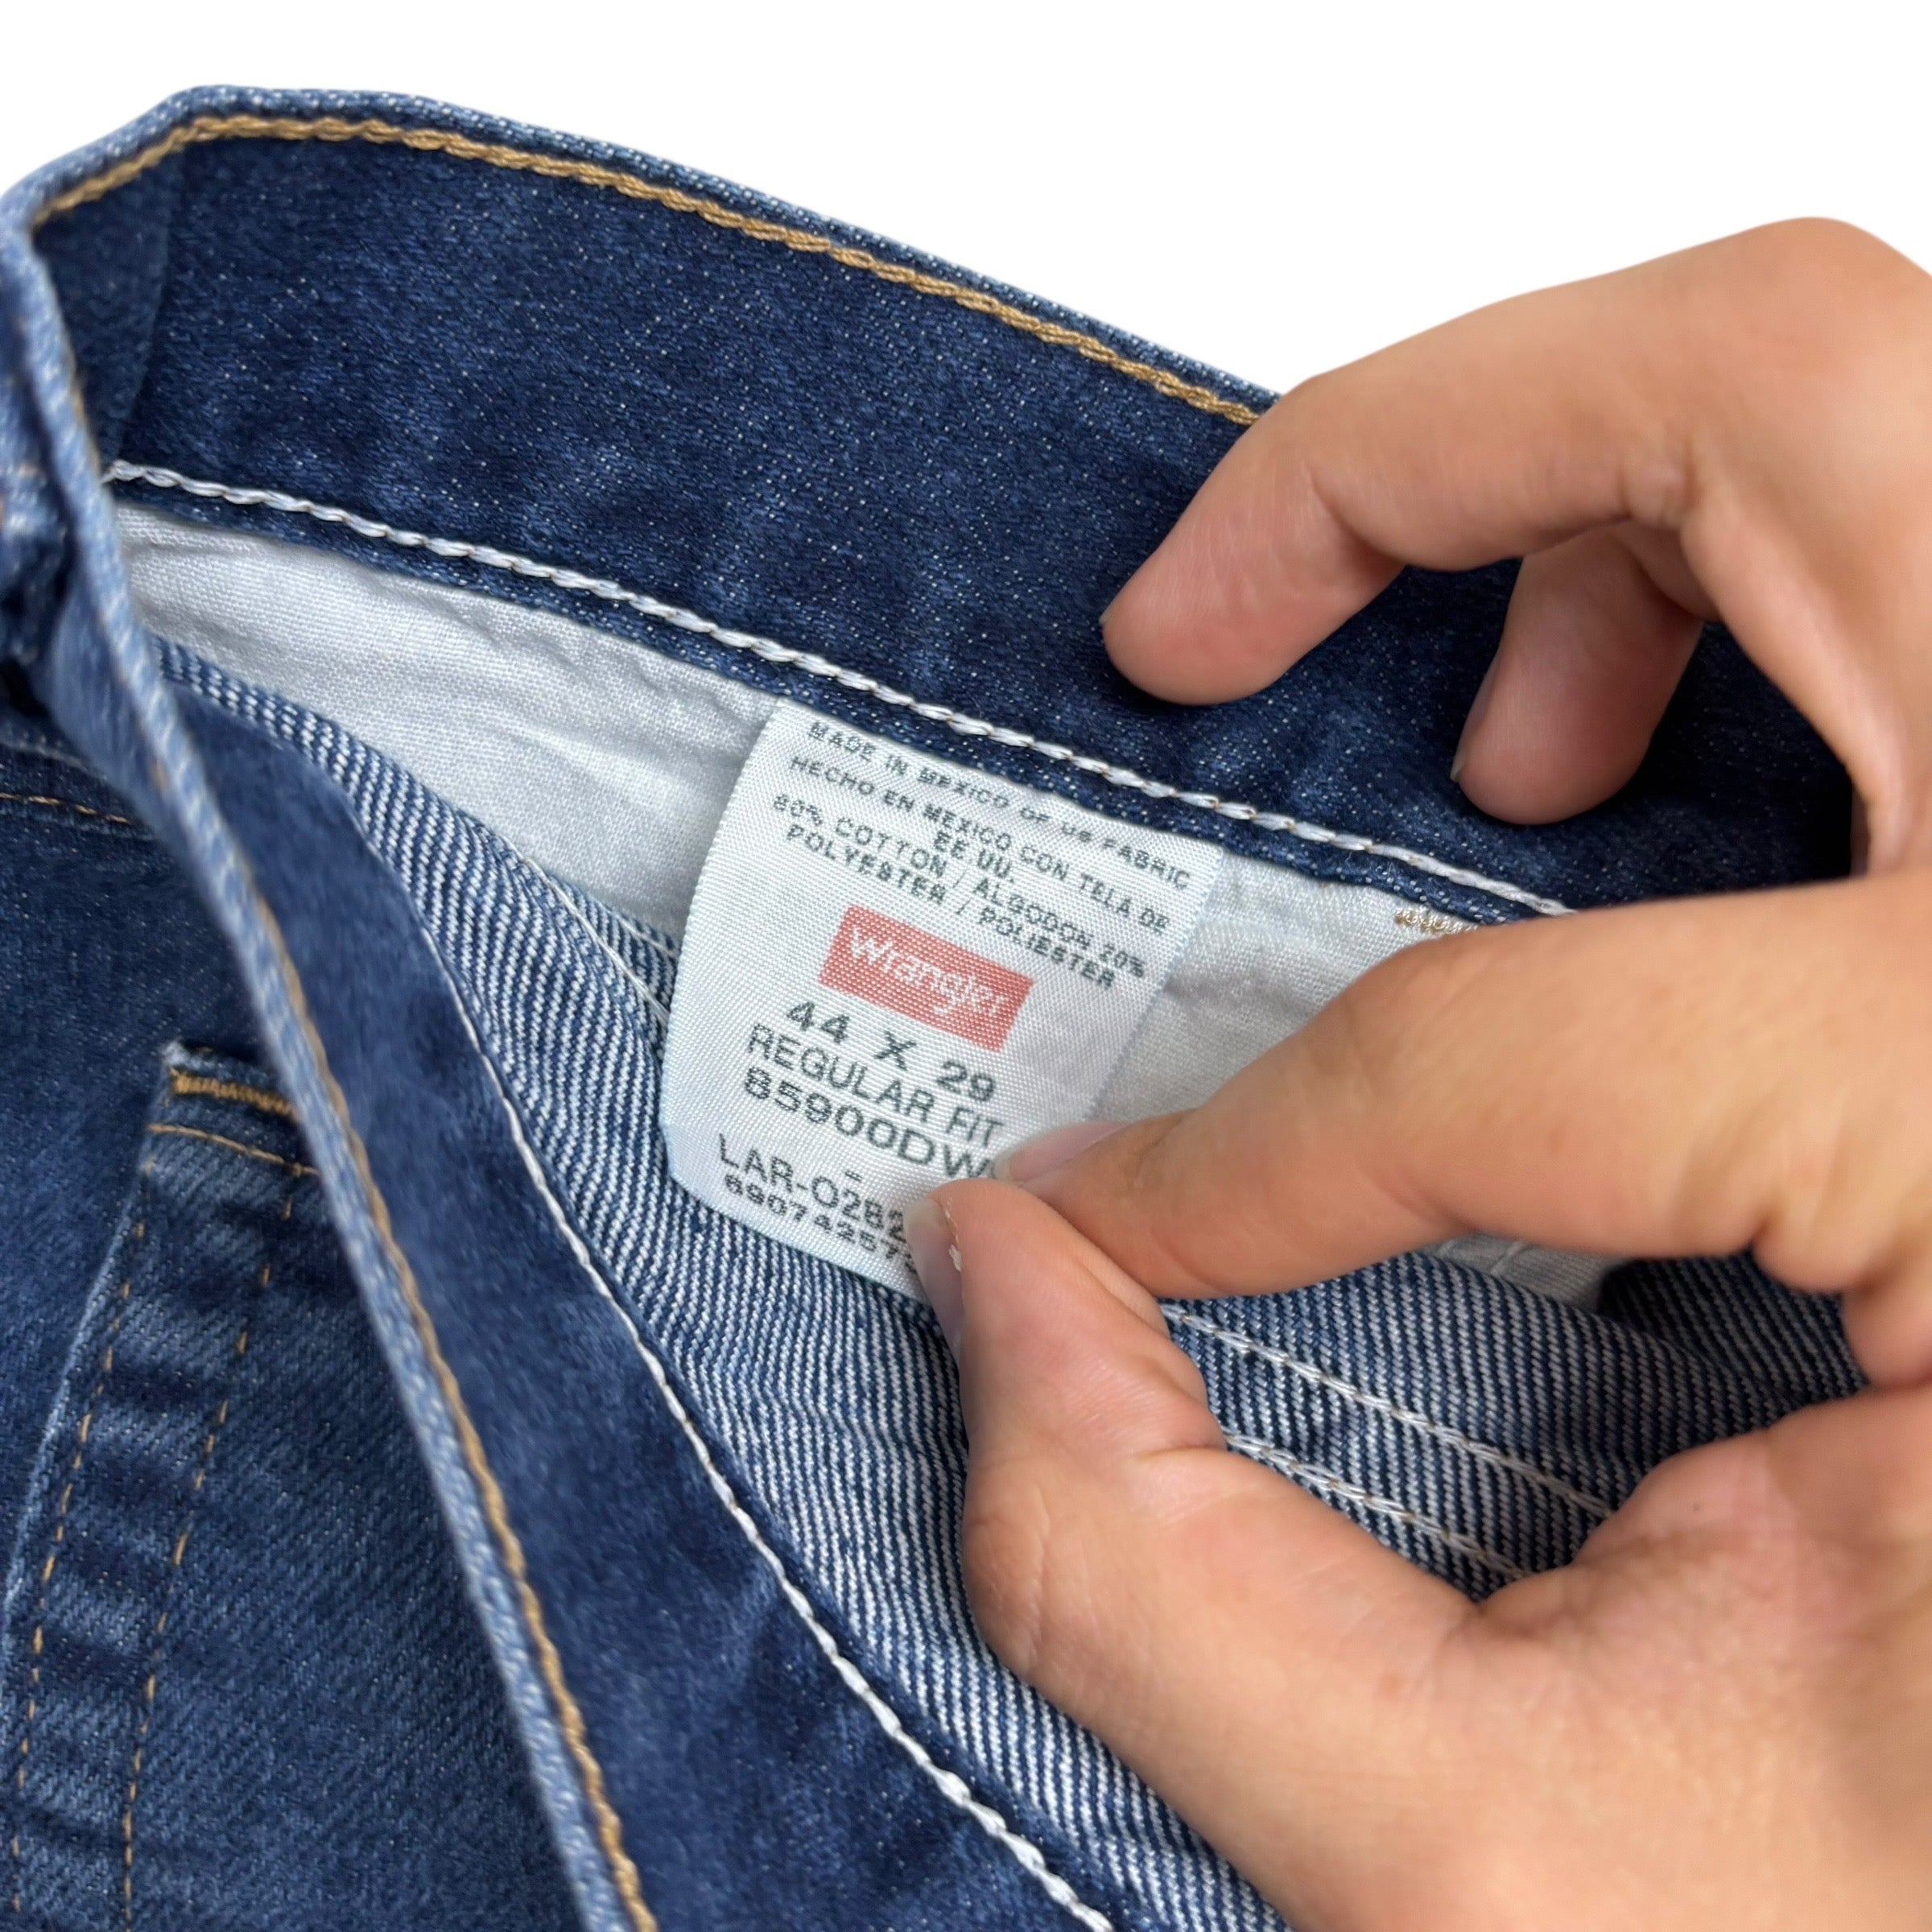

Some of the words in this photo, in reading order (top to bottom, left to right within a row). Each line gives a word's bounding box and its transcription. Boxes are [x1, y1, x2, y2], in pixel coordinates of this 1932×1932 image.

[791, 756, 875, 795] HECHO
[885, 790, 914, 812] EN
[924, 803, 1012, 851] MEXICO
[1020, 846, 1070, 881] CON
[1079, 873, 1132, 918] TELA
[1139, 908, 1170, 935] DE
[807, 721, 876, 762] MADE
[886, 754, 908, 776] IN
[918, 769, 1009, 808] MEXICO
[1103, 839, 1190, 890] FABRIC
[786, 824, 947, 905] POLYESTER
[978, 906, 1116, 989] POLIESTER
[835, 817, 947, 878] COTTON
[972, 877, 1094, 950] ALGODON
[1099, 943, 1146, 978] 20%
[849, 927, 1009, 1016] Wrangler
[748, 1023, 935, 1122] REGULAR
[946, 1106, 1005, 1147] FIT
[786, 1001, 850, 1044] 44
[936, 1060, 997, 1102] 29
